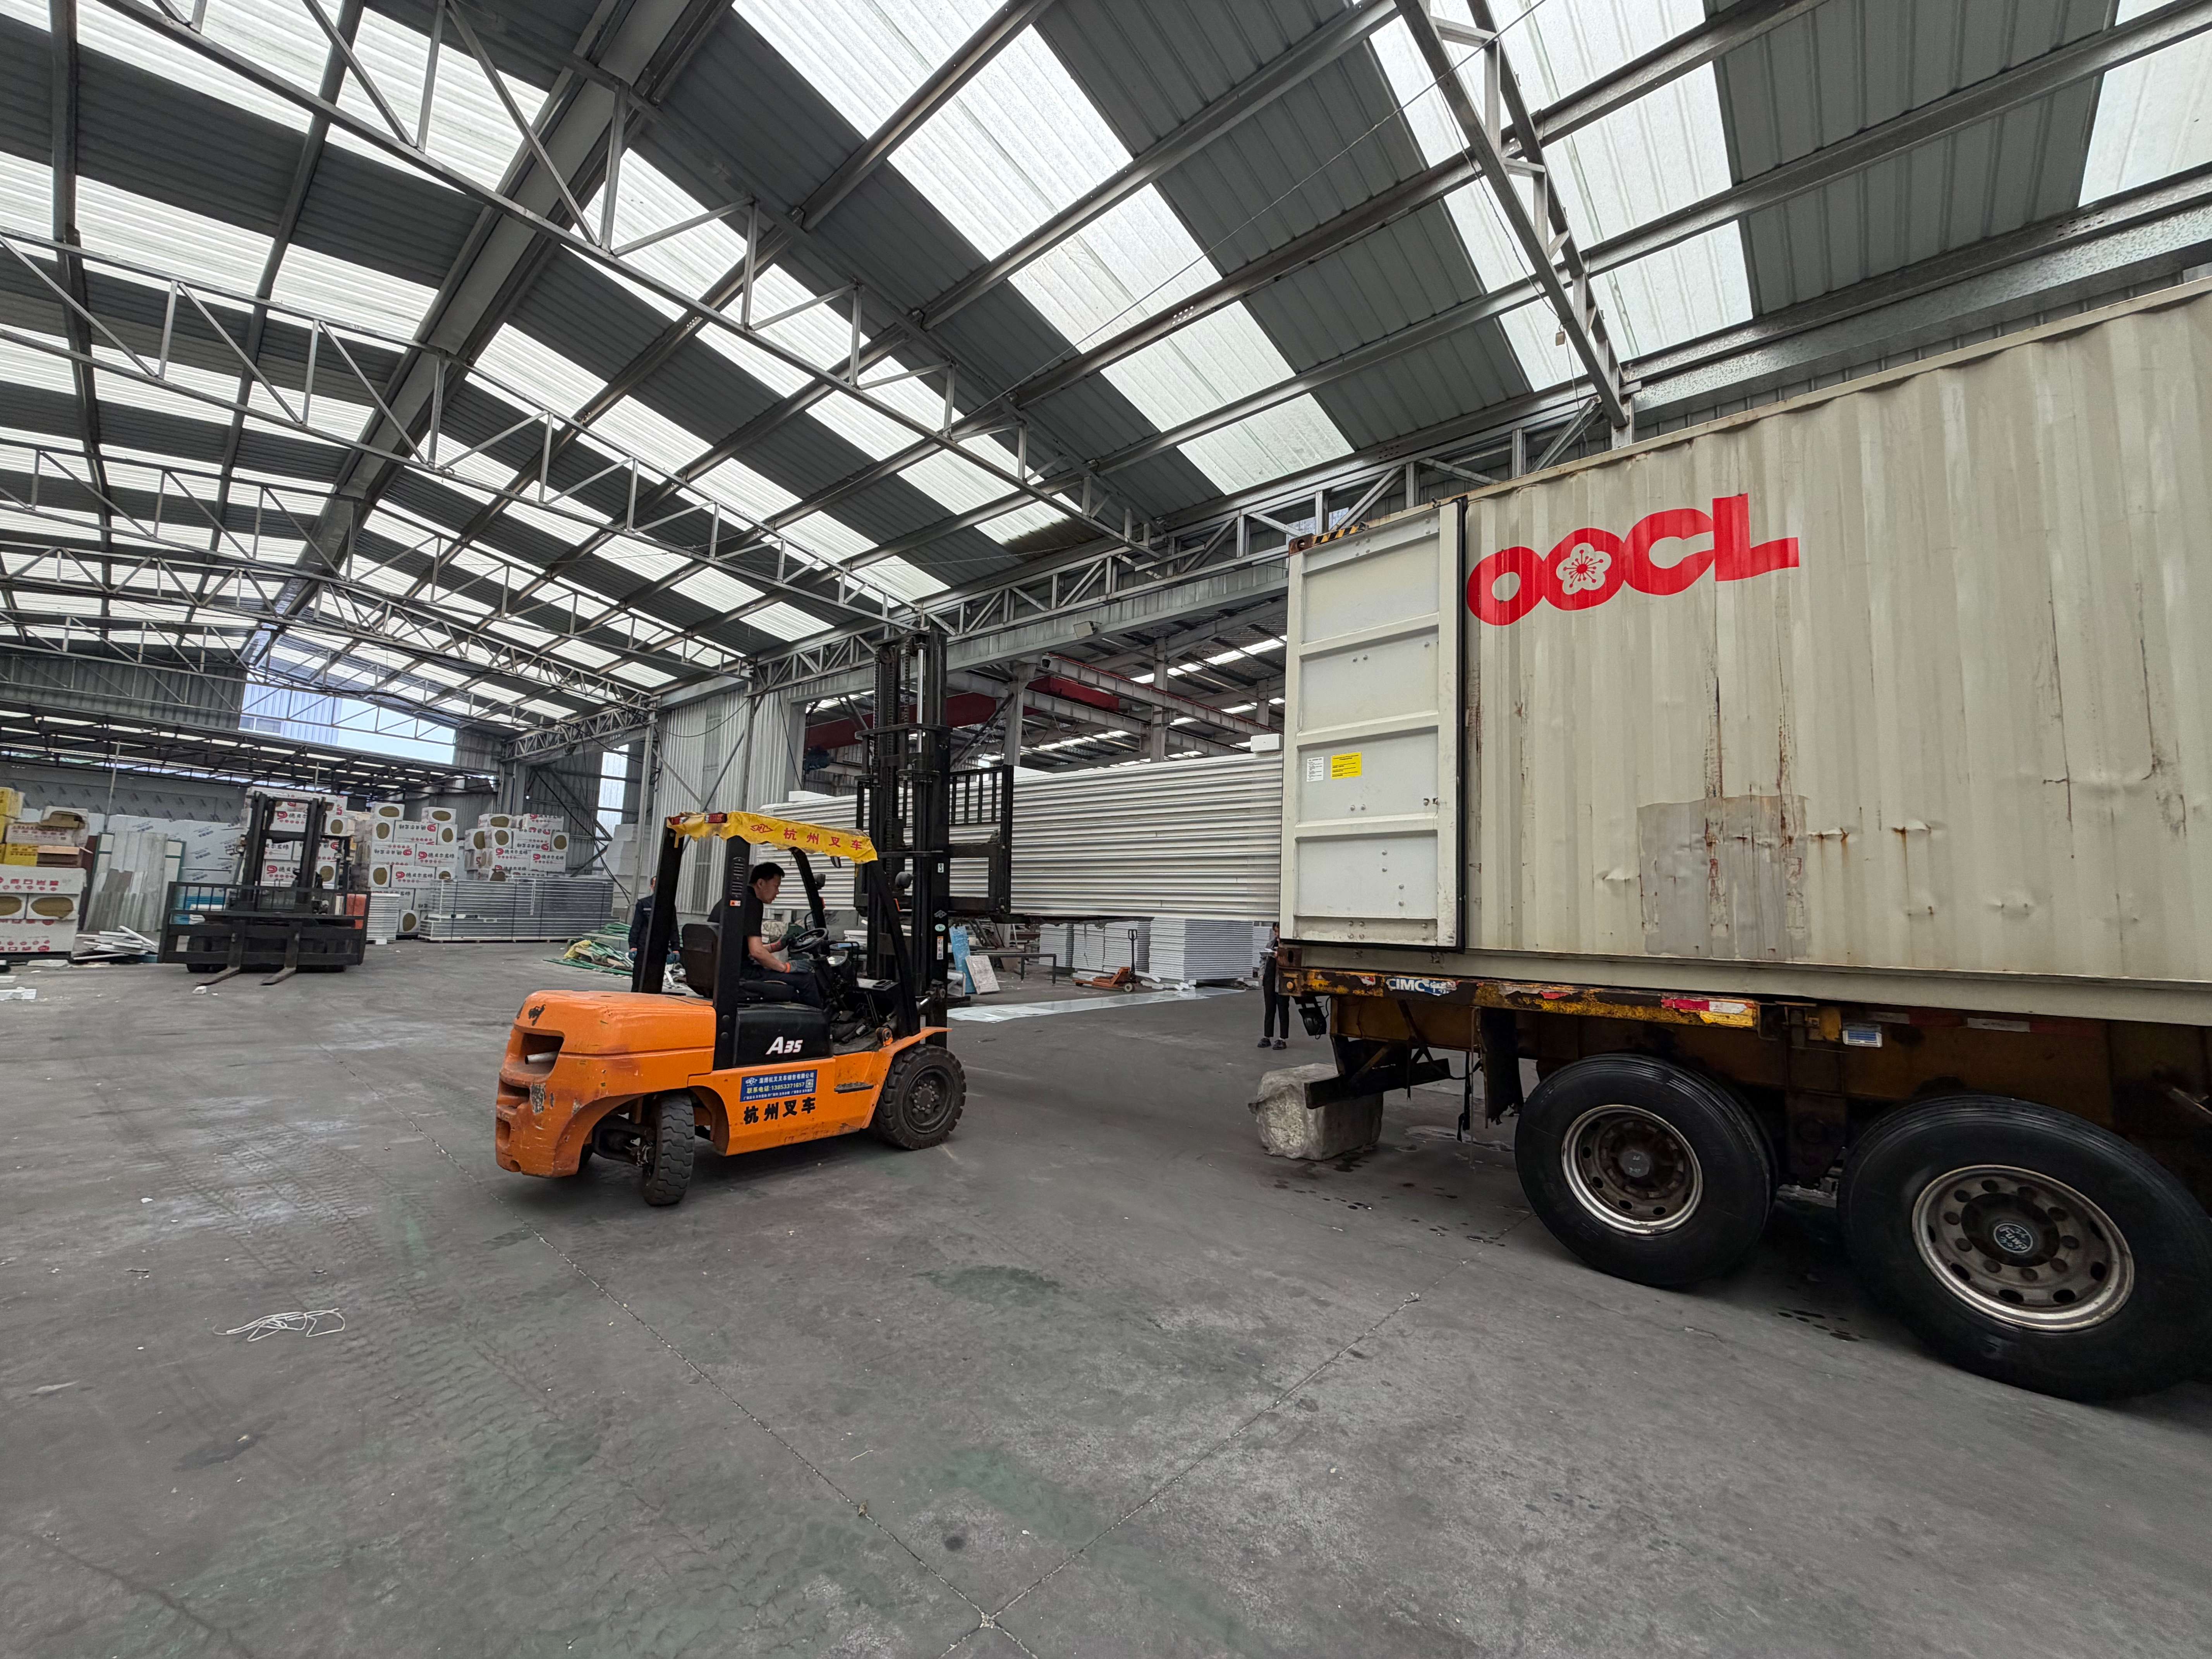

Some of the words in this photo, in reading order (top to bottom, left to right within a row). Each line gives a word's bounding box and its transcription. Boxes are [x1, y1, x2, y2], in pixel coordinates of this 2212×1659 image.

[1467, 493, 1799, 625] OOCL
[783, 828, 862, 850] 杭州叉车
[1386, 978, 1430, 992] CIMC
[765, 1036, 803, 1055] A35
[744, 1097, 816, 1125] 杭州叉车
